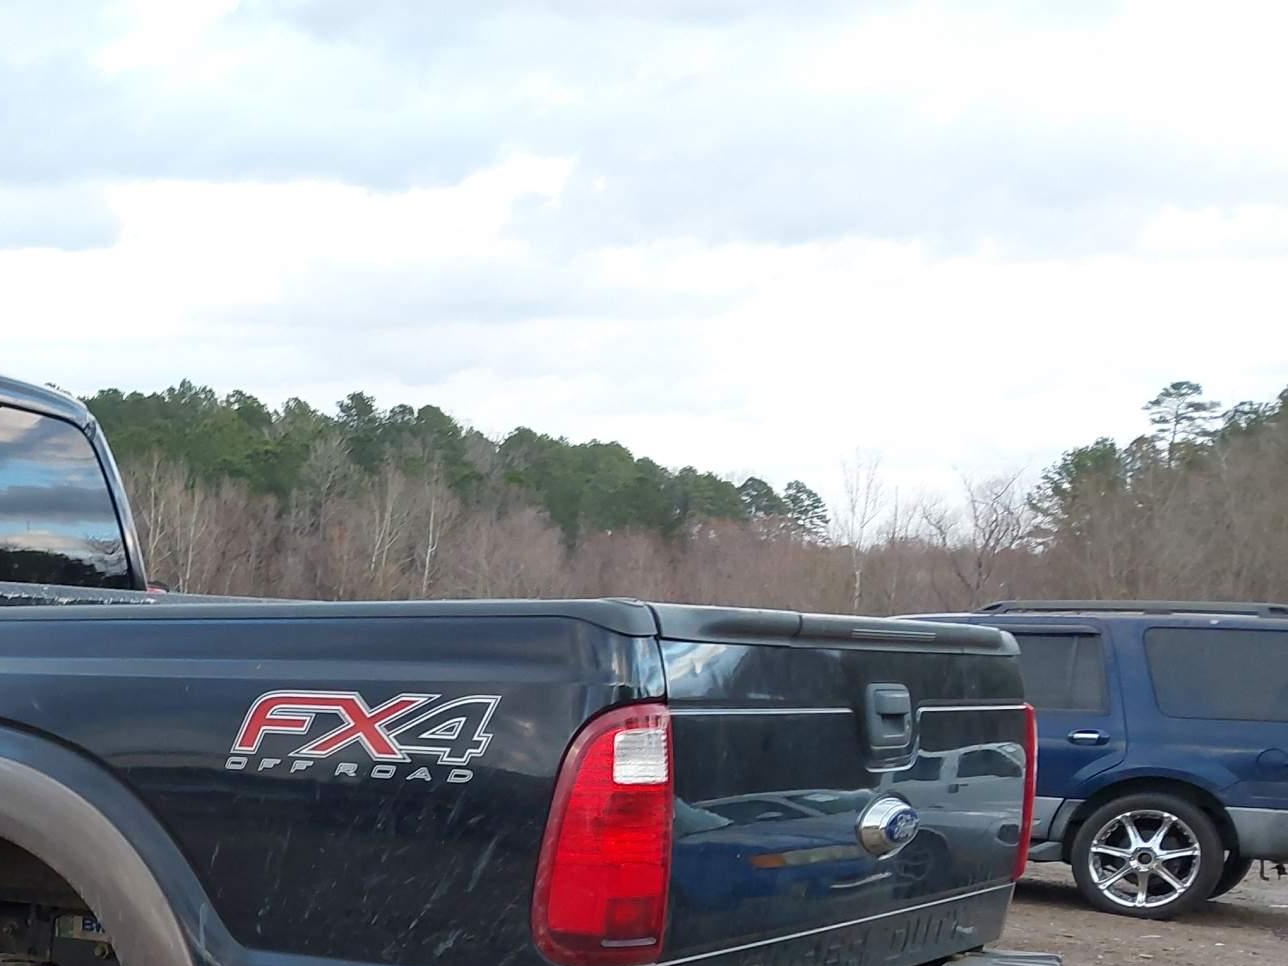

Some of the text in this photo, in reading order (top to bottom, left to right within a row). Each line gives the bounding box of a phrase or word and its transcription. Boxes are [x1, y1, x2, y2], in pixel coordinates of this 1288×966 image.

[229, 689, 502, 766] FX4
[224, 756, 474, 784] OFF ROAD
